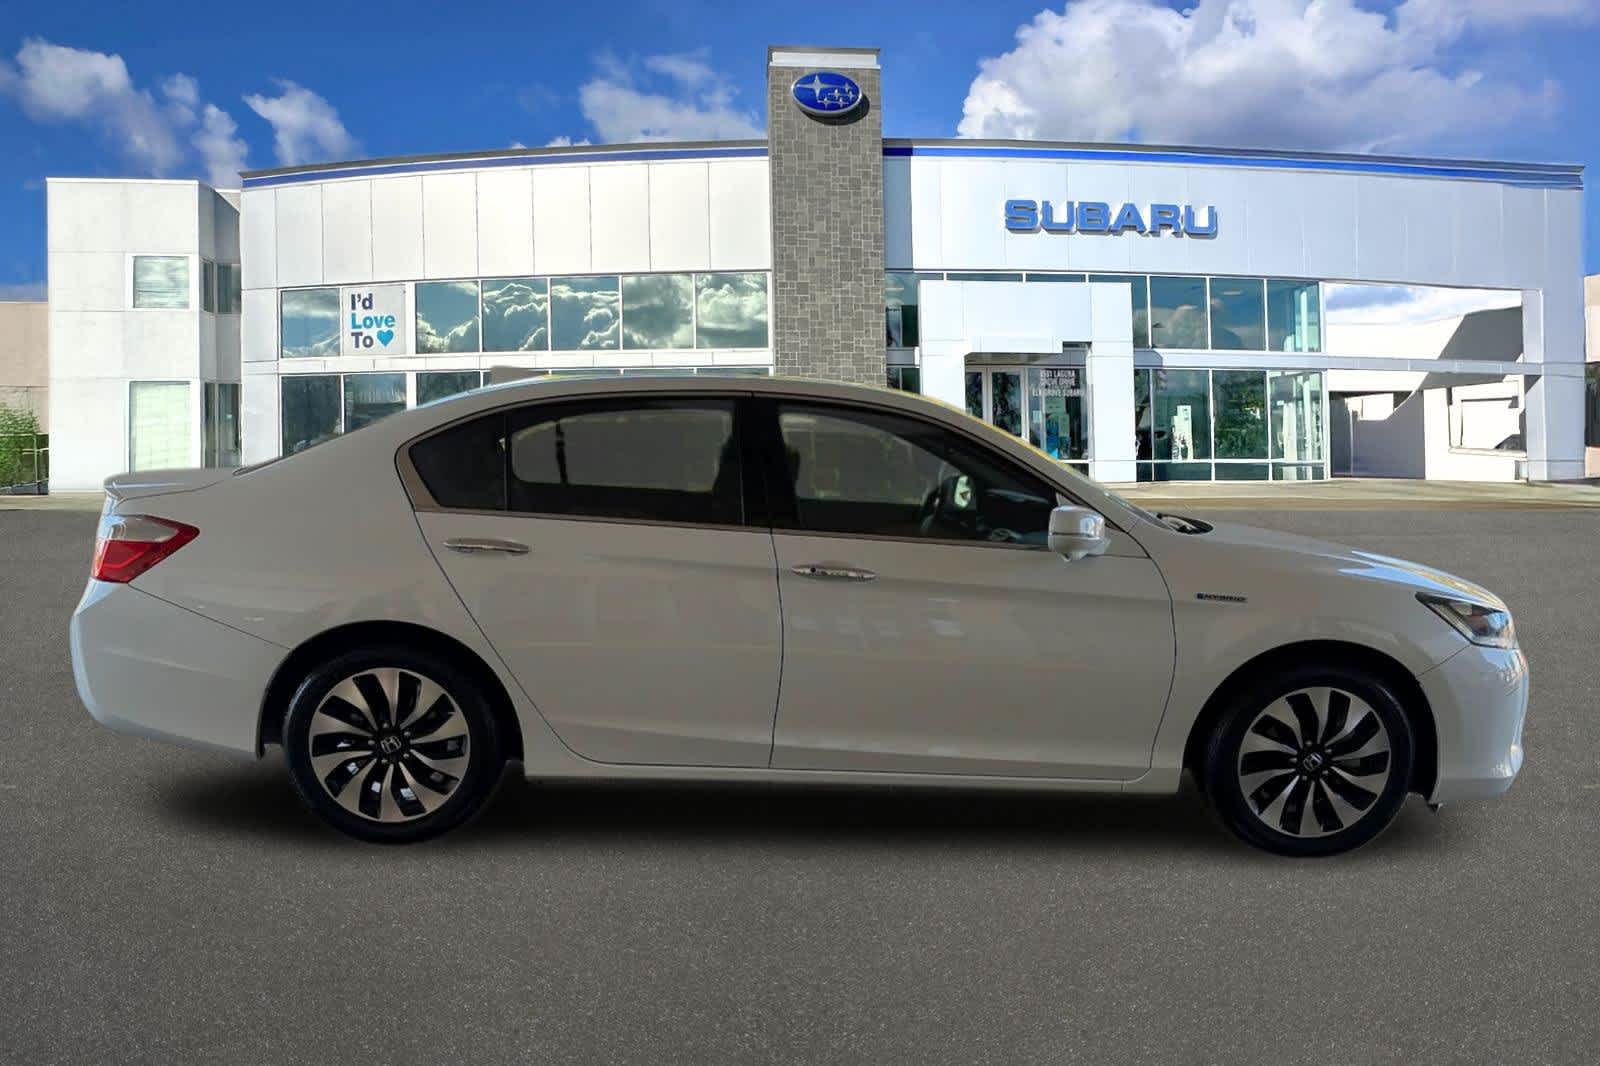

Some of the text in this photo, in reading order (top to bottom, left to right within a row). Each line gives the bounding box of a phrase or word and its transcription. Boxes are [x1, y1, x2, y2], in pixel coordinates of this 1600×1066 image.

[1004, 199, 1218, 239] SUBARU
[350, 293, 373, 310] I'd
[351, 313, 396, 329] Love
[351, 332, 374, 348] To
